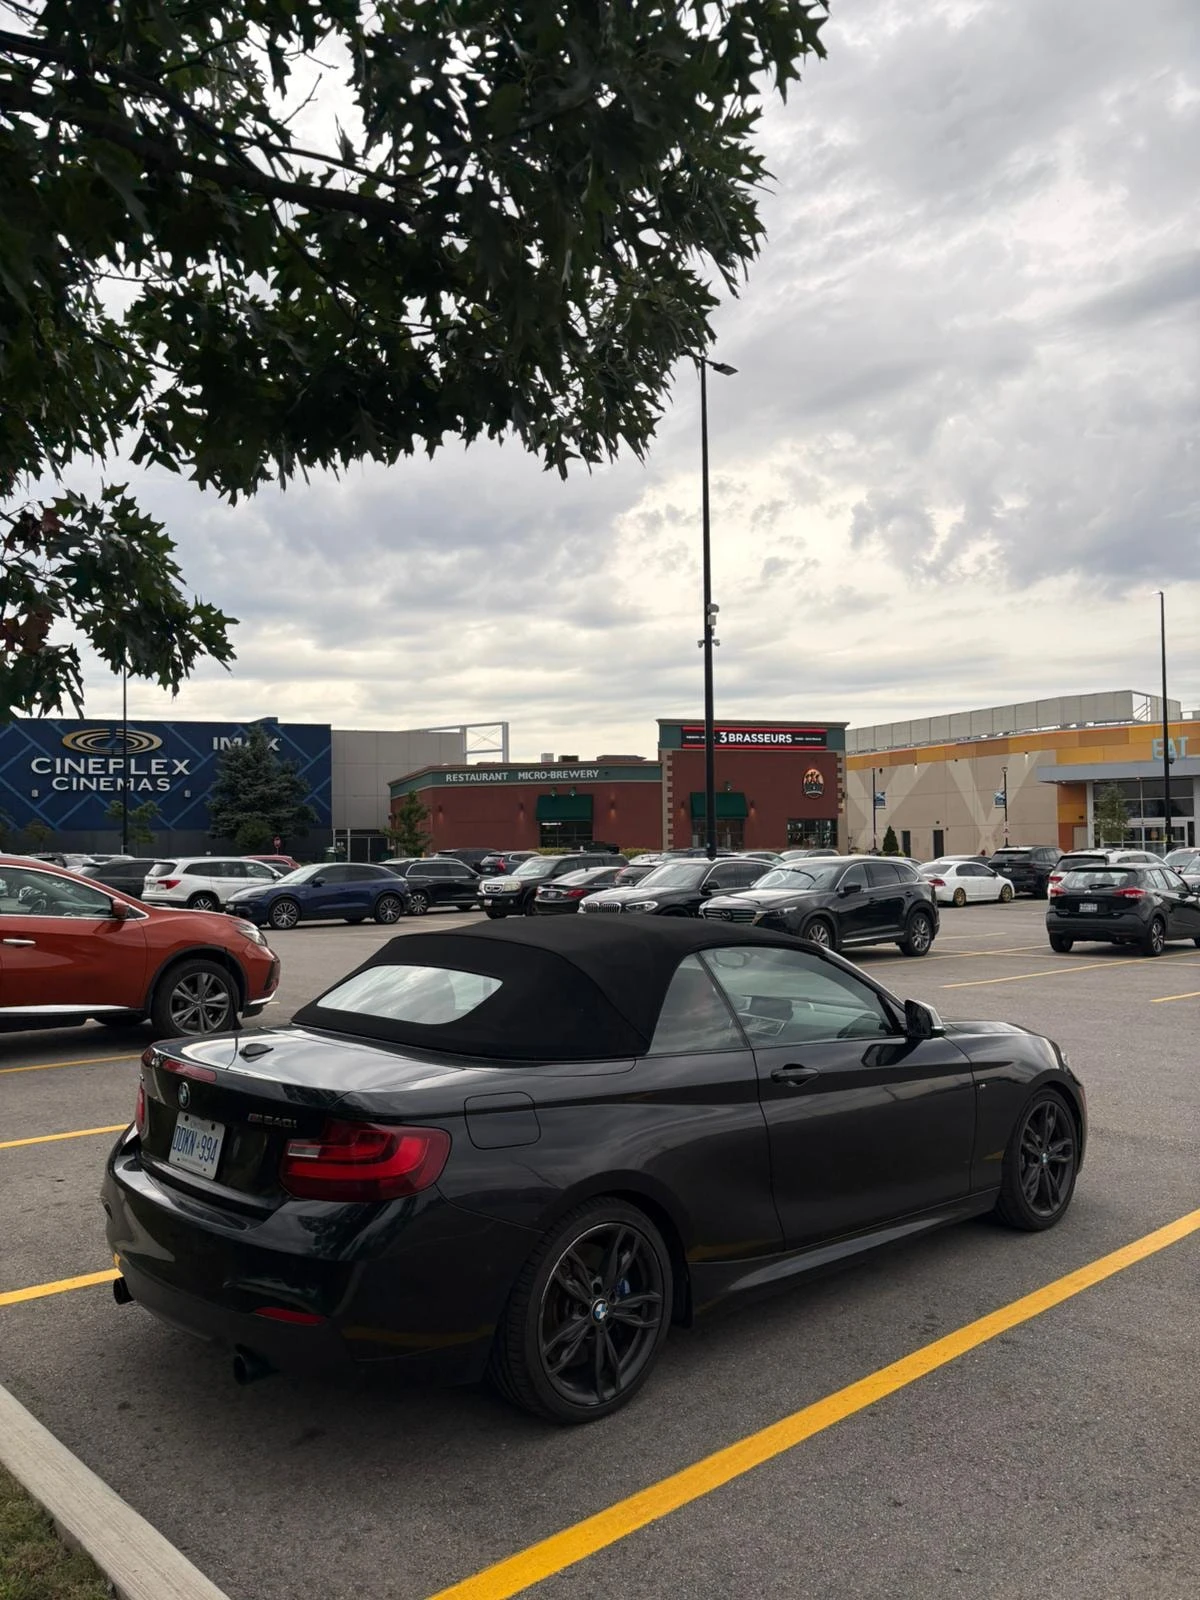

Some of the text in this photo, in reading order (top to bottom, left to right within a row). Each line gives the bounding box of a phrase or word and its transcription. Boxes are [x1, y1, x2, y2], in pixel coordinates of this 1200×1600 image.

[212, 736, 281, 752] IMX
[719, 731, 728, 744] 3
[728, 733, 792, 744] BRASSEURS
[30, 757, 191, 776] CINEPLEX
[51, 776, 171, 792] CINEMAS
[445, 769, 600, 783] RESTAURANT MICRO-BREWERY
